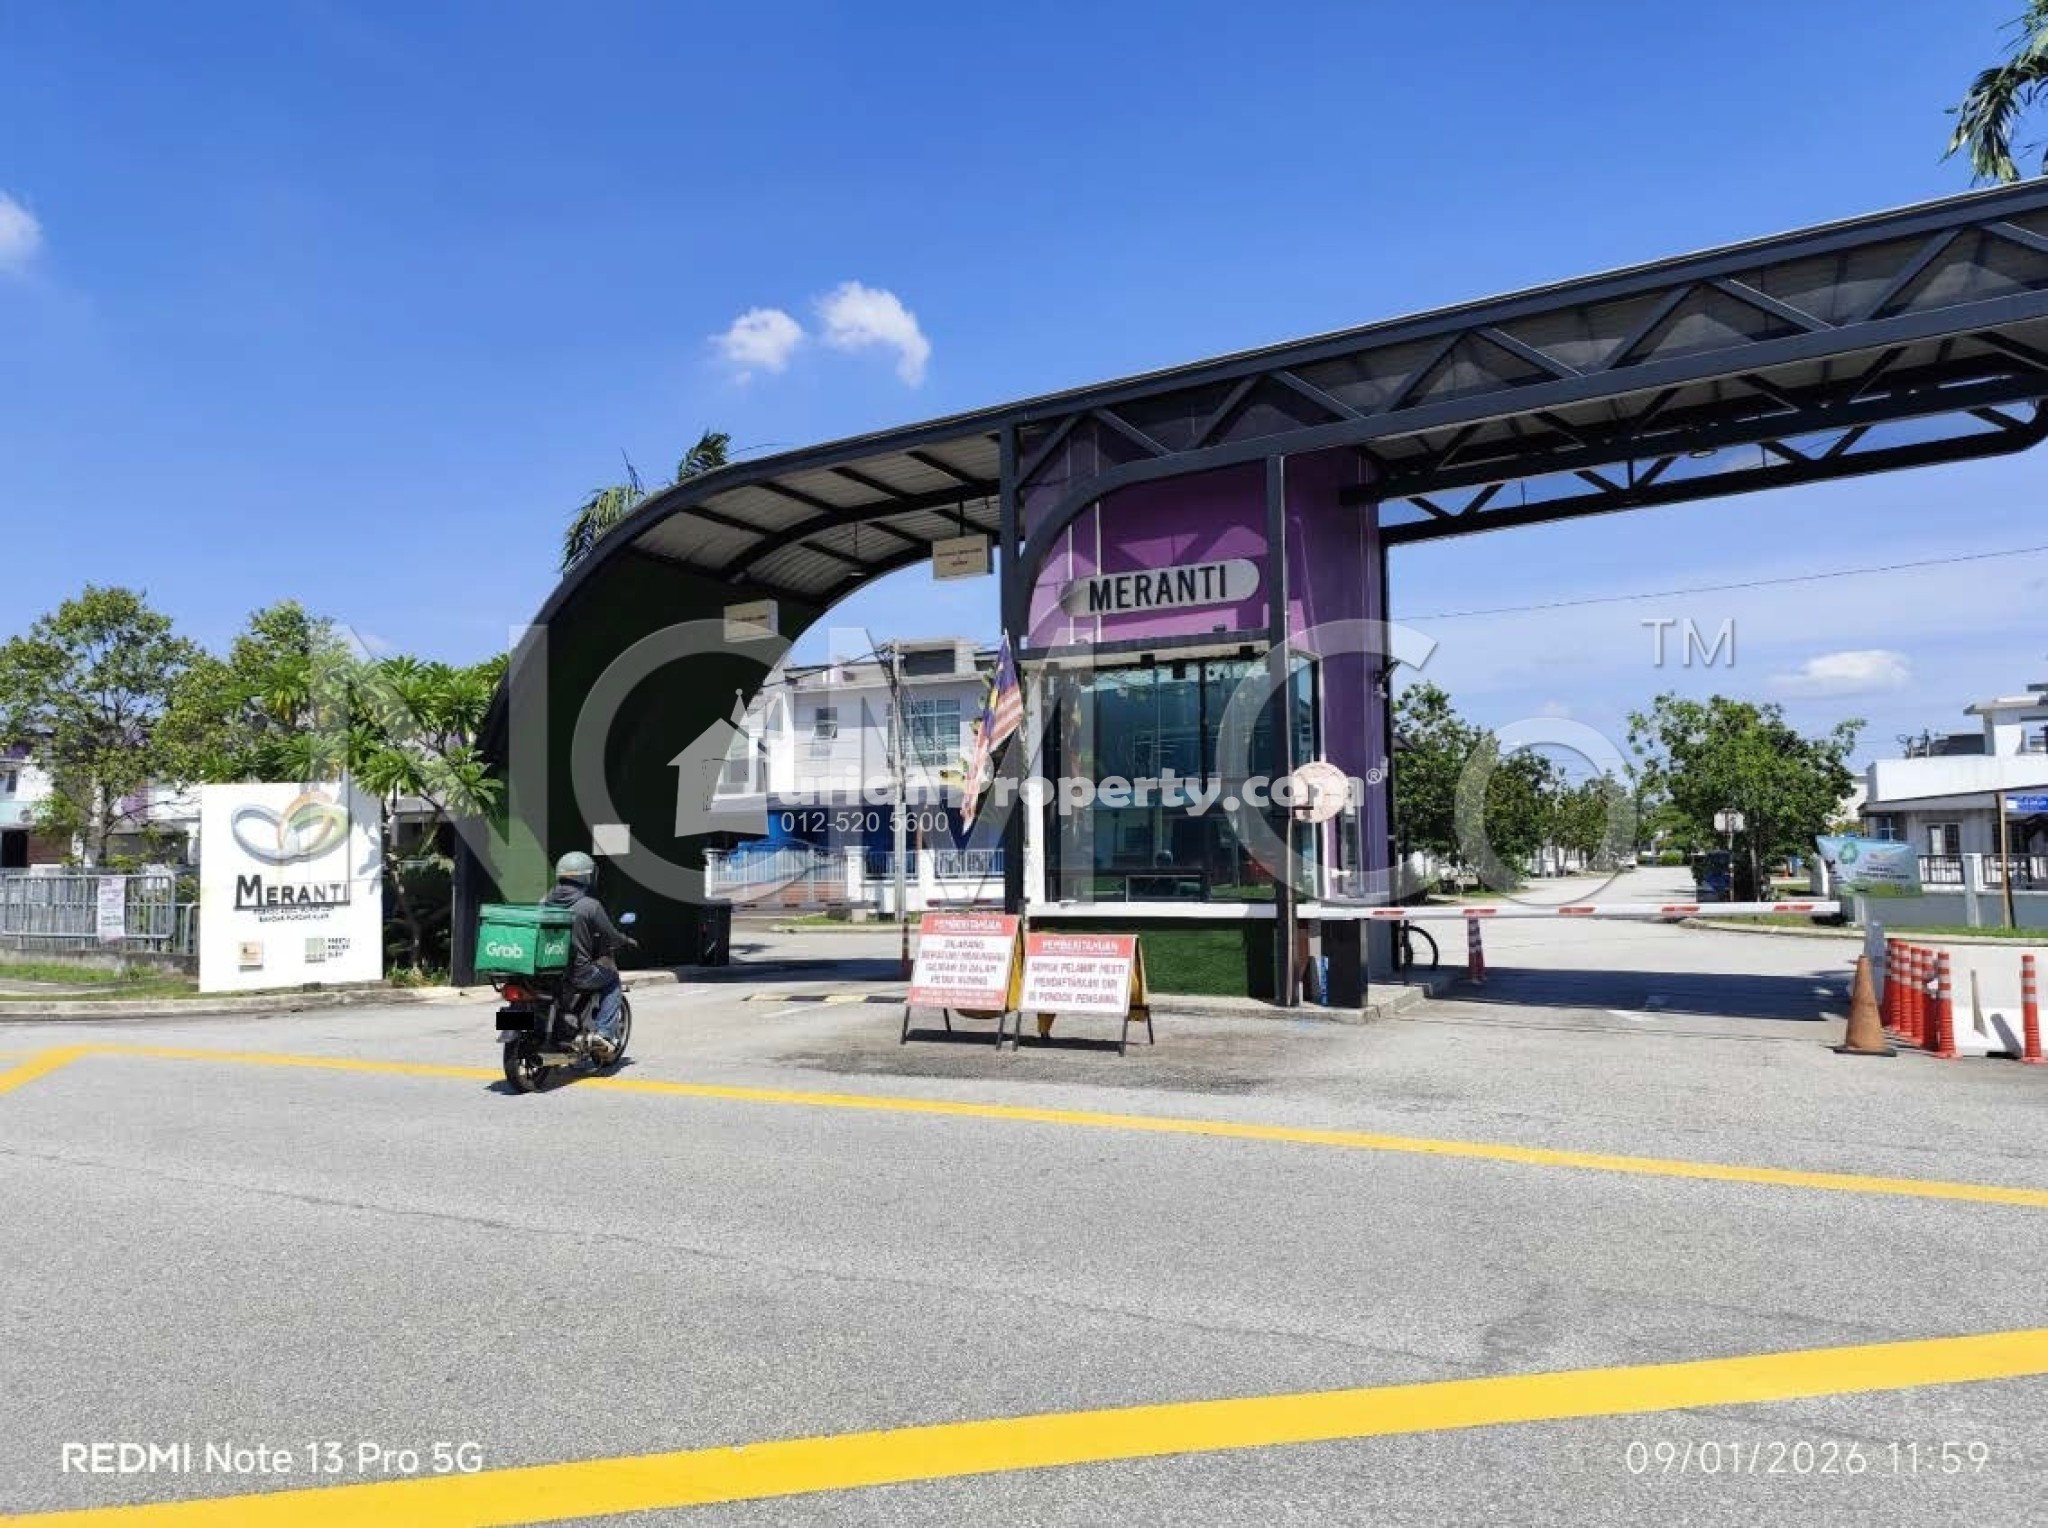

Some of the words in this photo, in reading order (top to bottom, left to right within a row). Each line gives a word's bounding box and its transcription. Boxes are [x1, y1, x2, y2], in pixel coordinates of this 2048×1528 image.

[1089, 565, 1226, 612] MERANTI
[236, 874, 348, 907] MERANTI
[486, 942, 524, 958] Grab
[1061, 962, 1097, 973] PELAWAT
